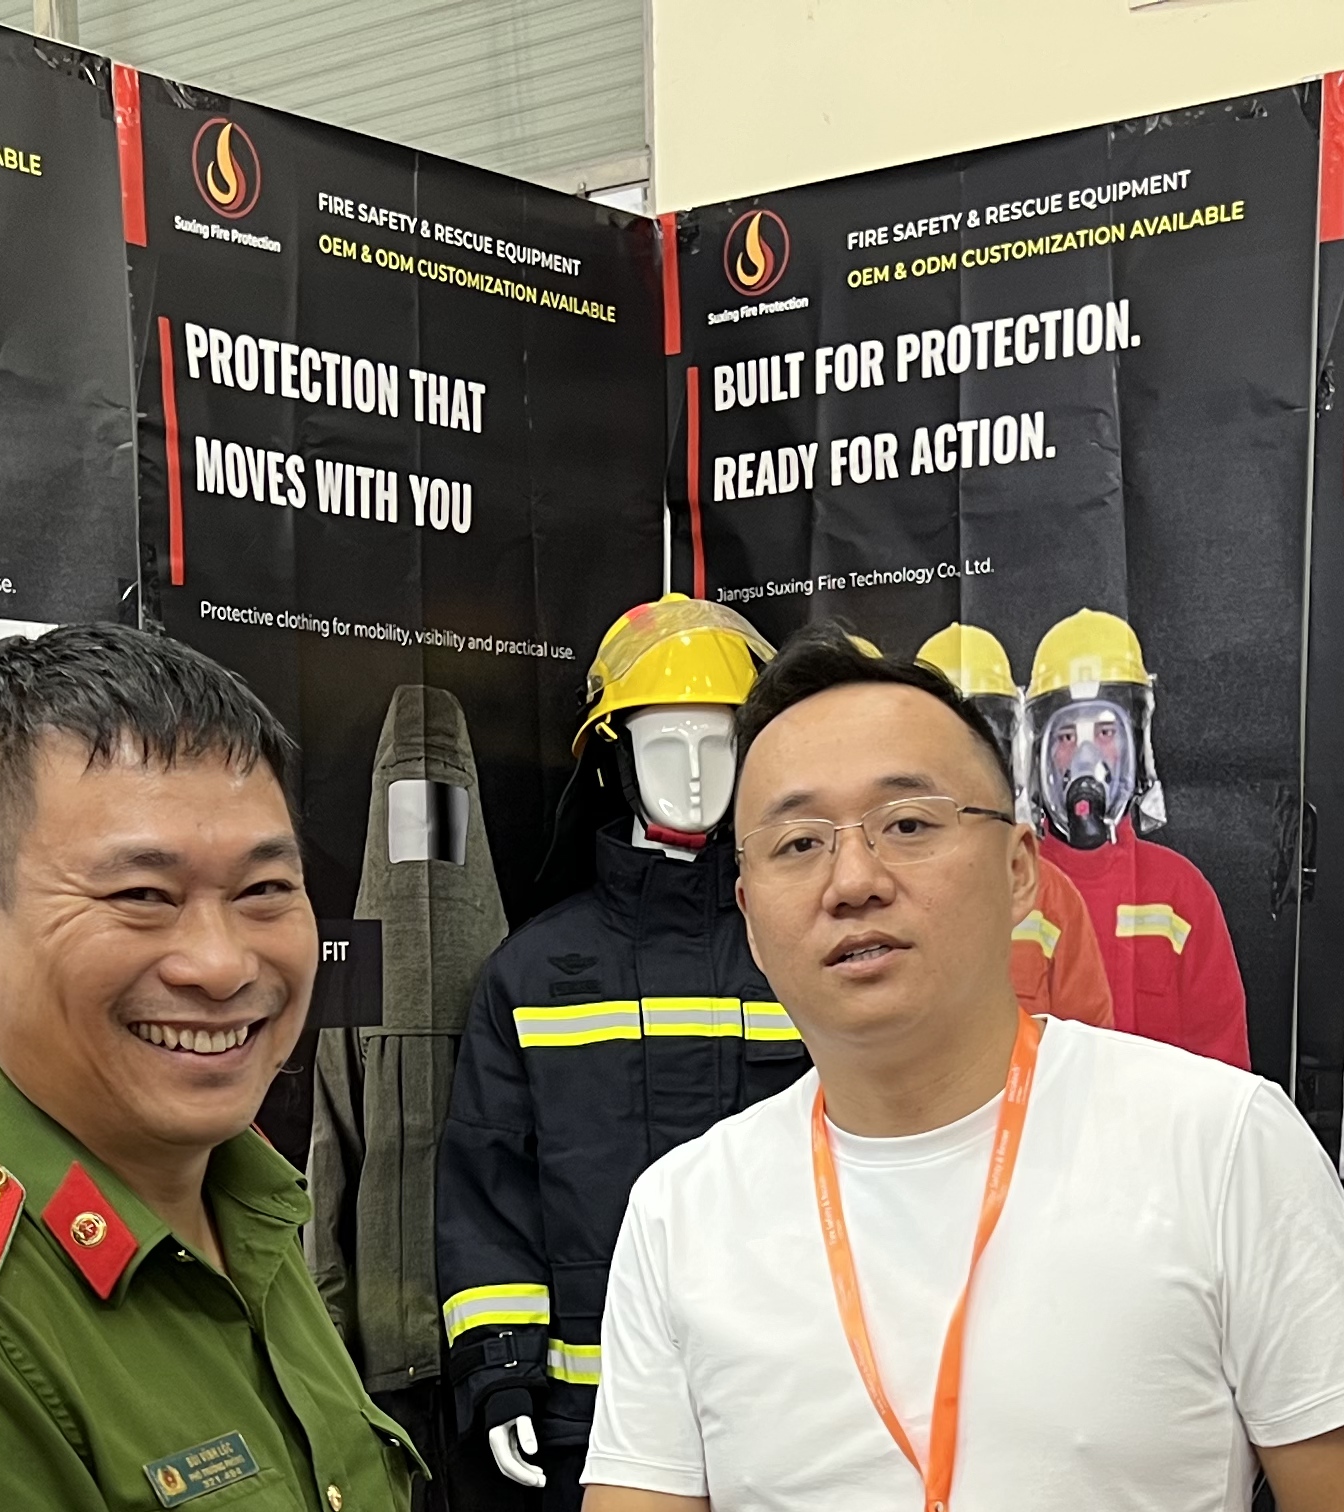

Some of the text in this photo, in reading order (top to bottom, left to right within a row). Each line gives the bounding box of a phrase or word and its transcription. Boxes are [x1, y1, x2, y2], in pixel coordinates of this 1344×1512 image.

[175, 216, 280, 252] Suxing Fire Protection
[319, 193, 581, 275] FIRE SAFETY & RESCUE EQUIPMENT
[848, 170, 1191, 250] FIRE SAFETY & RESCUE EQUIPMENT
[848, 201, 1244, 287] OEM & ODM CUSTOMIZATION AVAILABLE
[319, 235, 615, 322] OEM & ODM CUSTOMIZATION AVAILABLE
[708, 297, 808, 325] Suxing Fire Protection
[185, 323, 485, 433] PROTECTION THAT
[715, 299, 1140, 411] BUILT FOR PROTECTION.
[196, 436, 471, 533] MOVES WITH YOU
[714, 411, 1055, 501] READY FOR ACTION.
[717, 586, 763, 602] Jiangsu
[767, 579, 813, 596] Suxing
[818, 575, 845, 590] Fire
[849, 567, 934, 587] Technology
[966, 557, 994, 575] Ltd.
[201, 601, 575, 659] Protective clothing for mobility, visibility and practical use.
[323, 942, 349, 961] FIT
